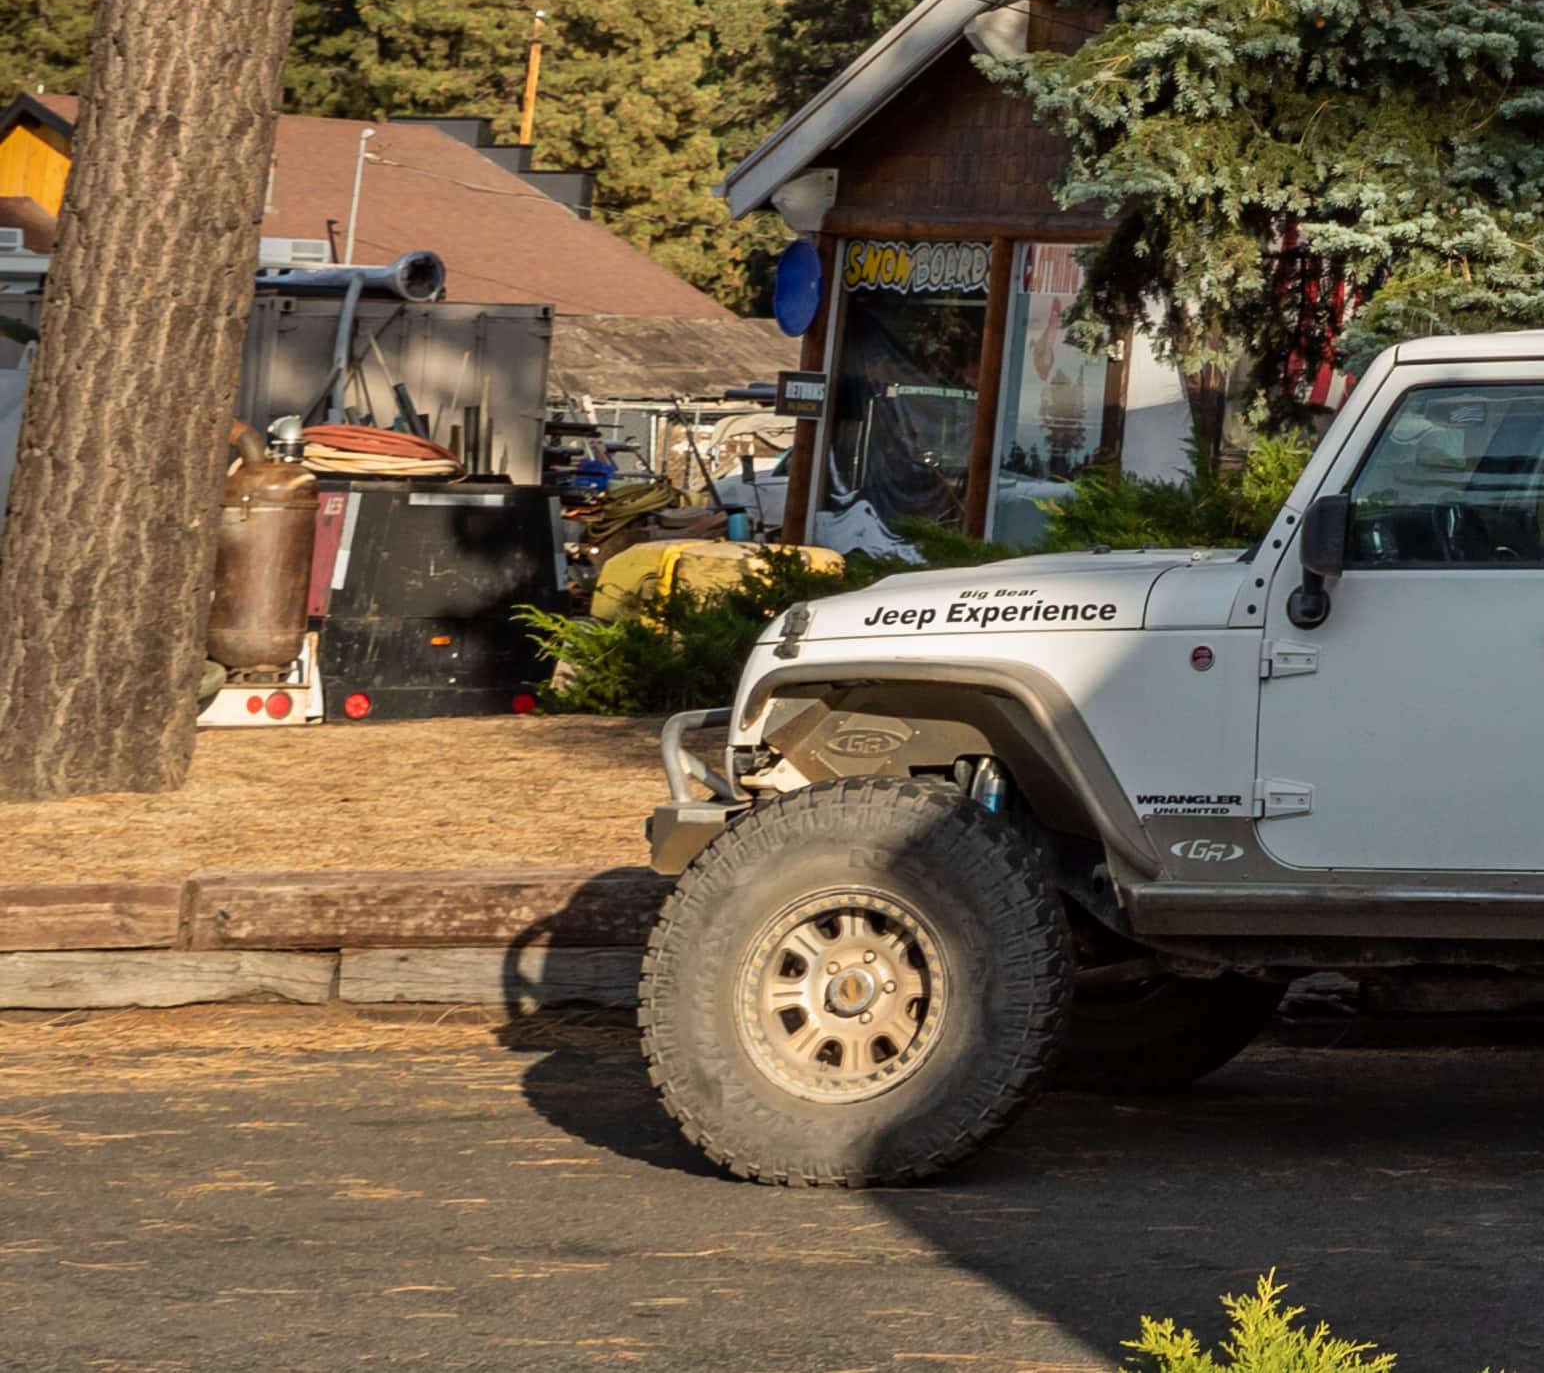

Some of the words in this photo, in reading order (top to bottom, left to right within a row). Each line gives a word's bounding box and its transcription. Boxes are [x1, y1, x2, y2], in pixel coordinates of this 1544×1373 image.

[960, 590, 988, 599] Big
[995, 589, 1038, 597] Bear
[864, 606, 937, 630] Jeep
[946, 600, 1118, 628] Experience
[1136, 795, 1242, 806] WRANGLER
